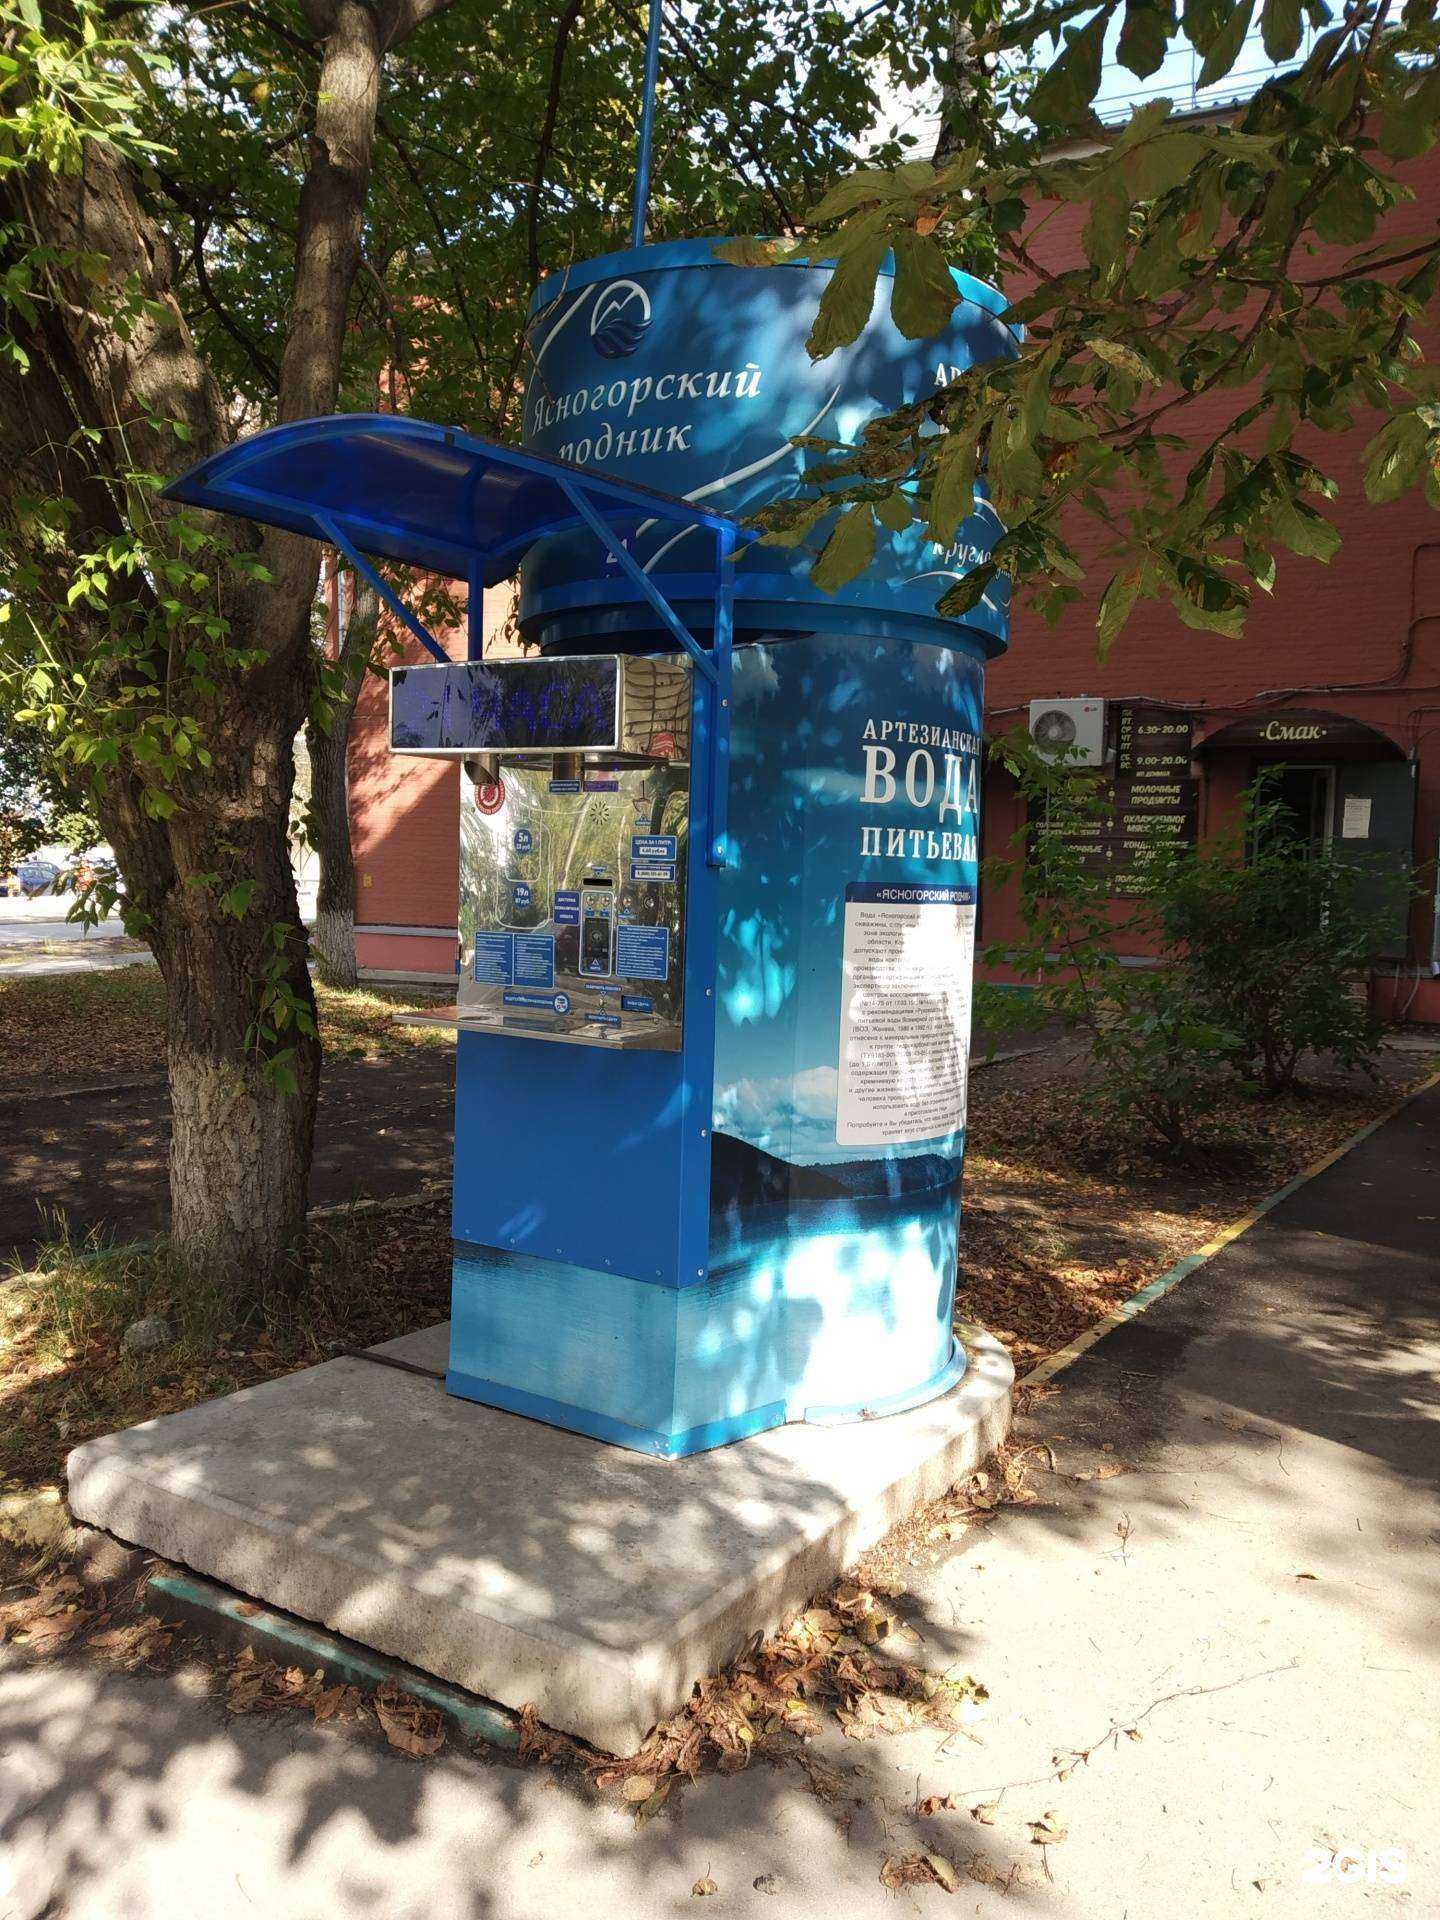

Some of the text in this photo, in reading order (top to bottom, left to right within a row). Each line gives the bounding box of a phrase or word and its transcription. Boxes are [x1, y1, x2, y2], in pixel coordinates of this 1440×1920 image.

[532, 362, 762, 436] Ясногорский
[1266, 720, 1321, 741] Смак
[860, 745, 978, 826] ВОДА
[1131, 785, 1182, 793] МОЛОЧНЫЕ
[1131, 796, 1181, 805] ПРОДУКТЫ
[1123, 815, 1186, 824] ОХЛАЖЕННОЕ
[860, 826, 977, 862] ПИТЬЕВАЯ
